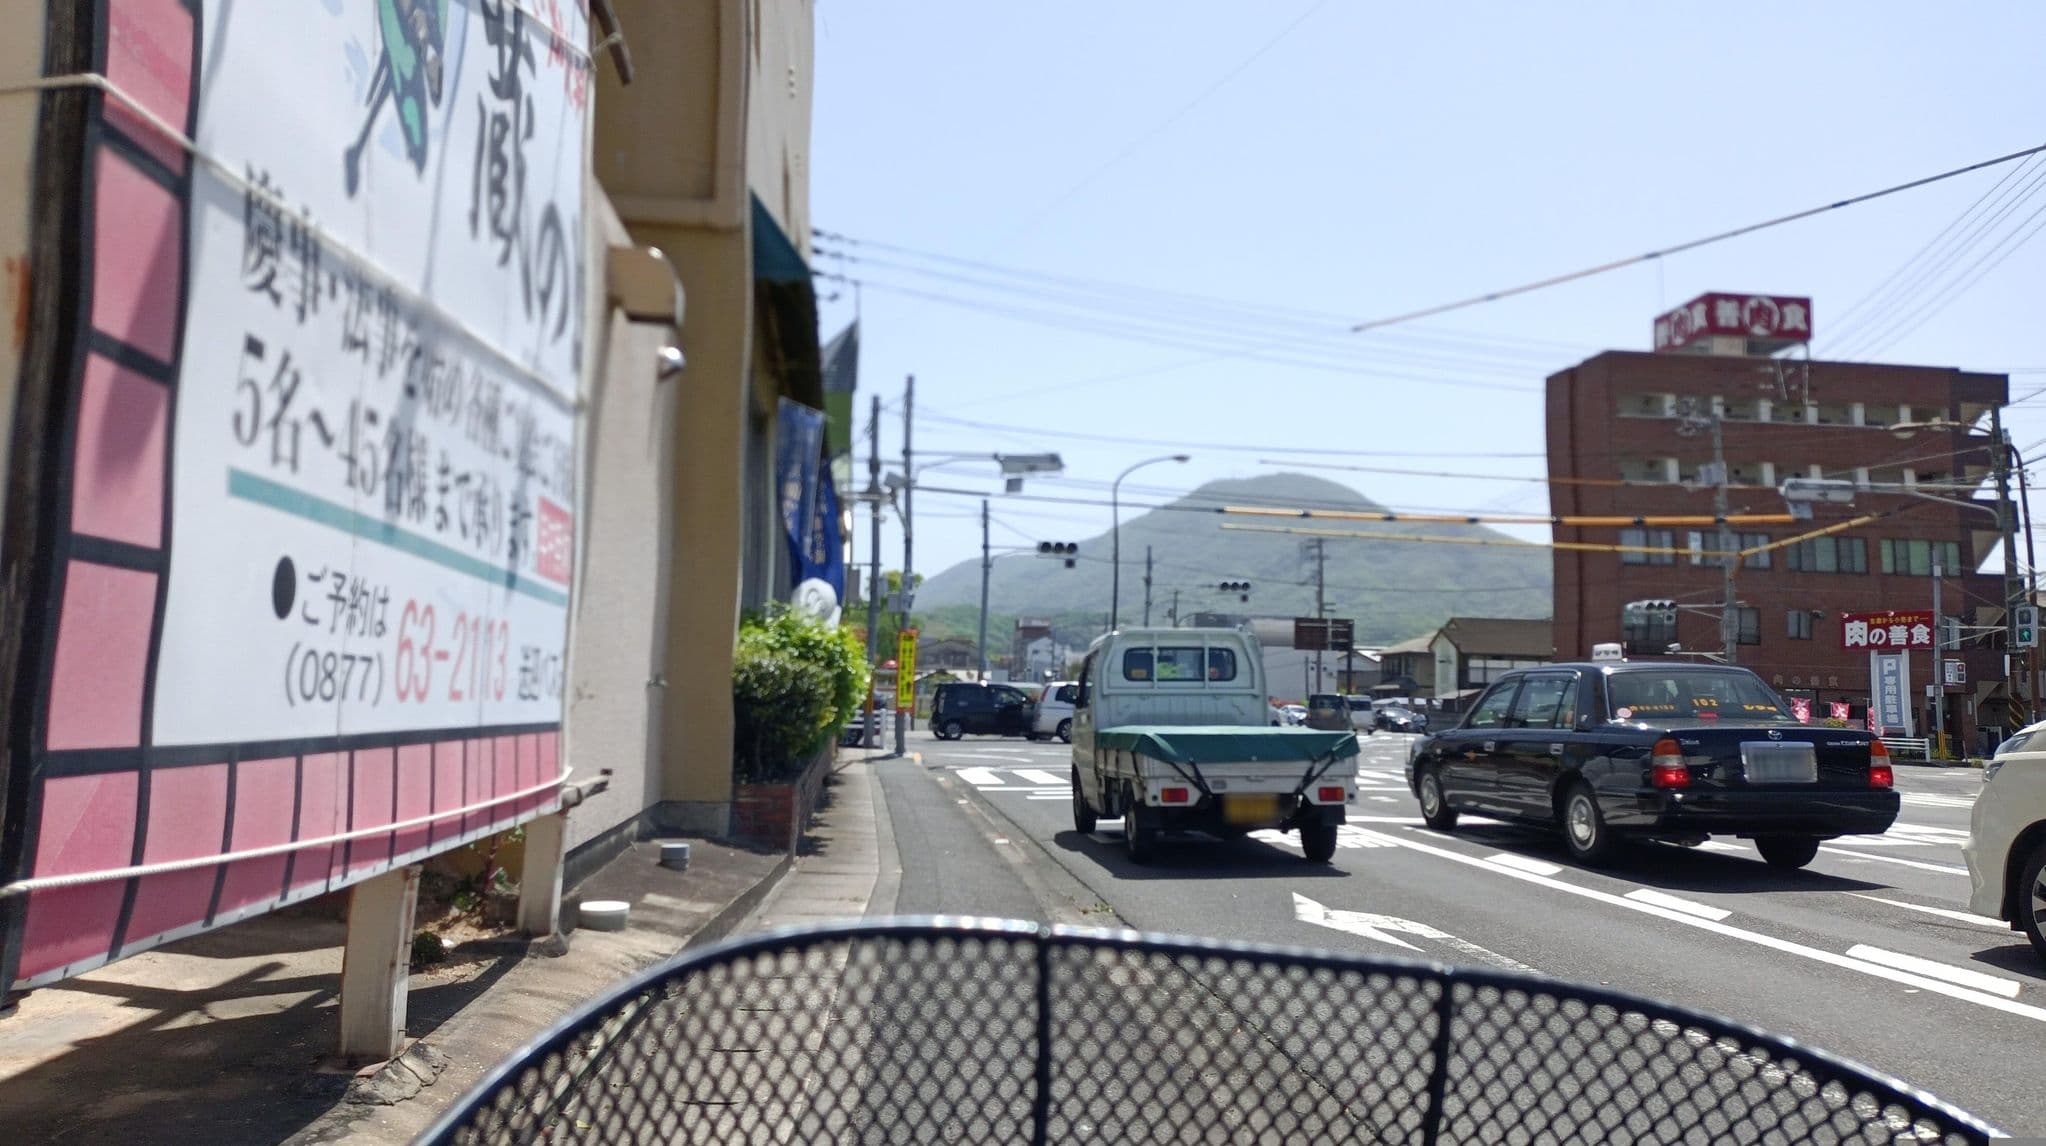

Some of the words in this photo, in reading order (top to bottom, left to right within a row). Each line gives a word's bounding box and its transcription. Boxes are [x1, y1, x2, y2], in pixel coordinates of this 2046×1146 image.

[303, 566, 388, 638] ご予約は
[1845, 620, 1931, 647] 肉の善食
[286, 642, 384, 706] (0877)
[397, 600, 509, 703] 63-2113
